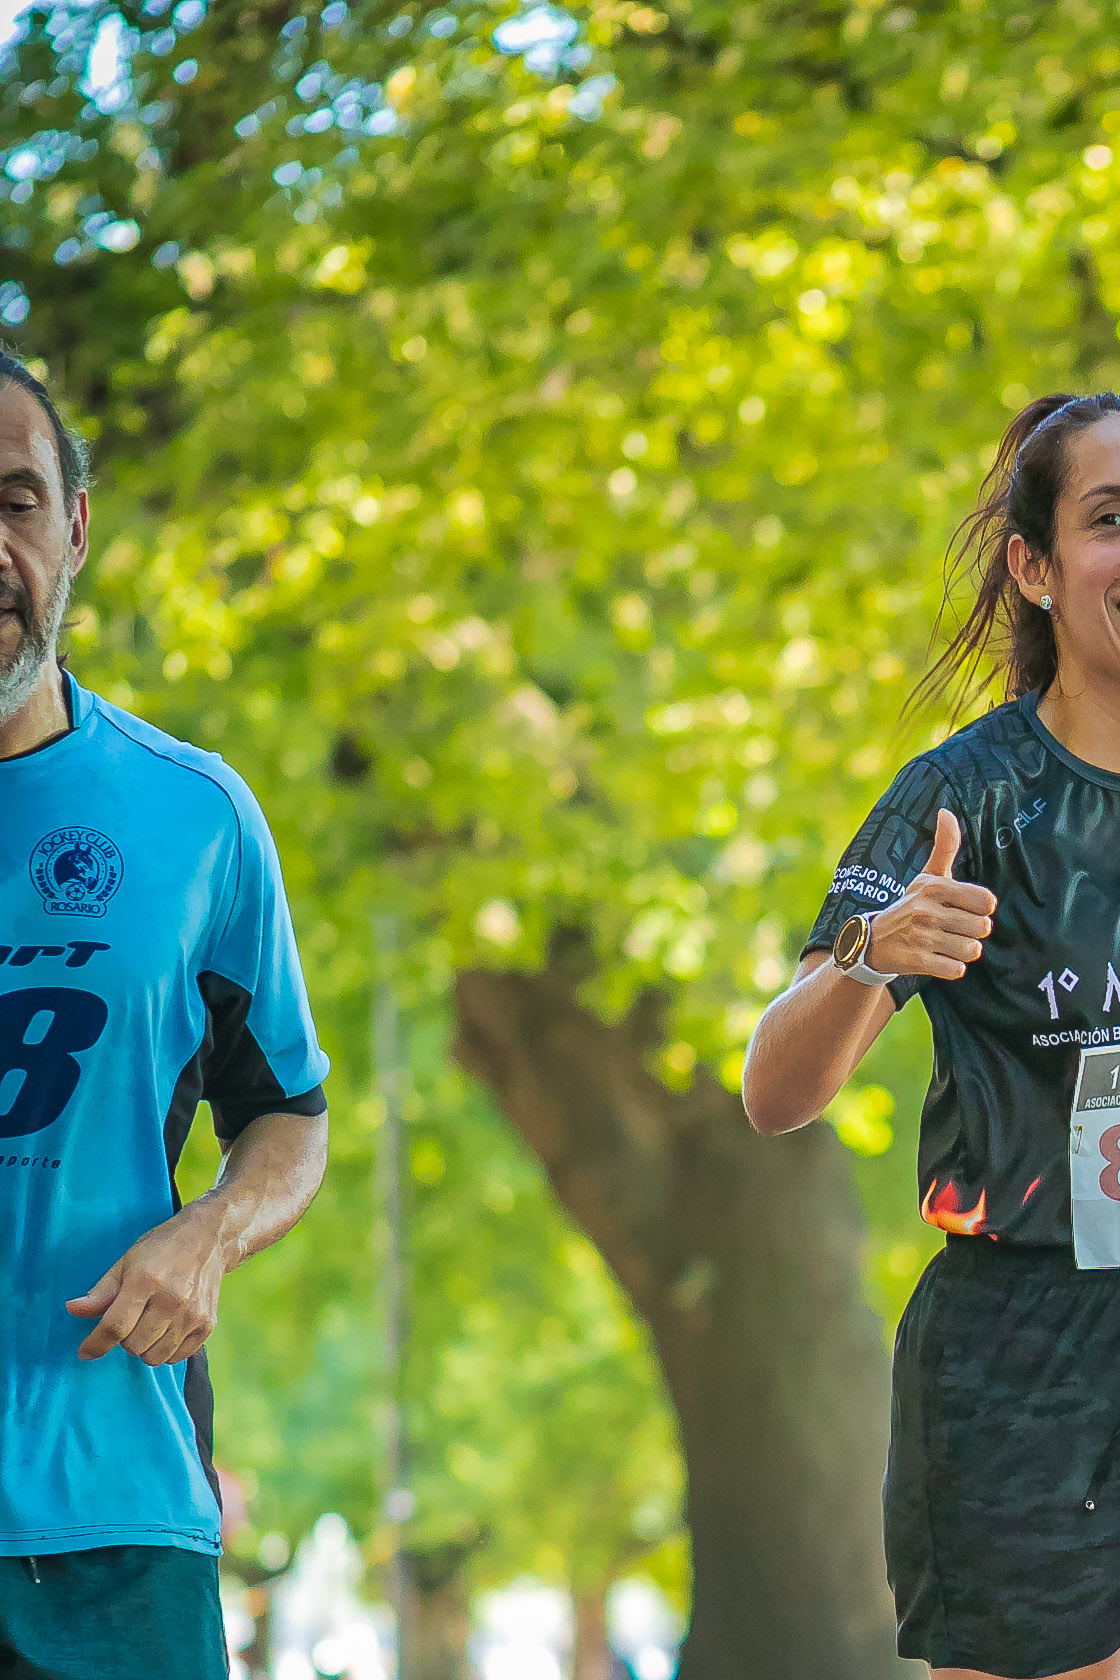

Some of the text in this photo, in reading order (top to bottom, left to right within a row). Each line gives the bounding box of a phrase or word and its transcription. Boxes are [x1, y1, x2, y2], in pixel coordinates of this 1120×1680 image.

[38, 830, 116, 859] JOCKEY CLUB
[50, 901, 101, 914] ROSARIO
[1032, 1026, 1110, 1047] ASOCIACIÓN
